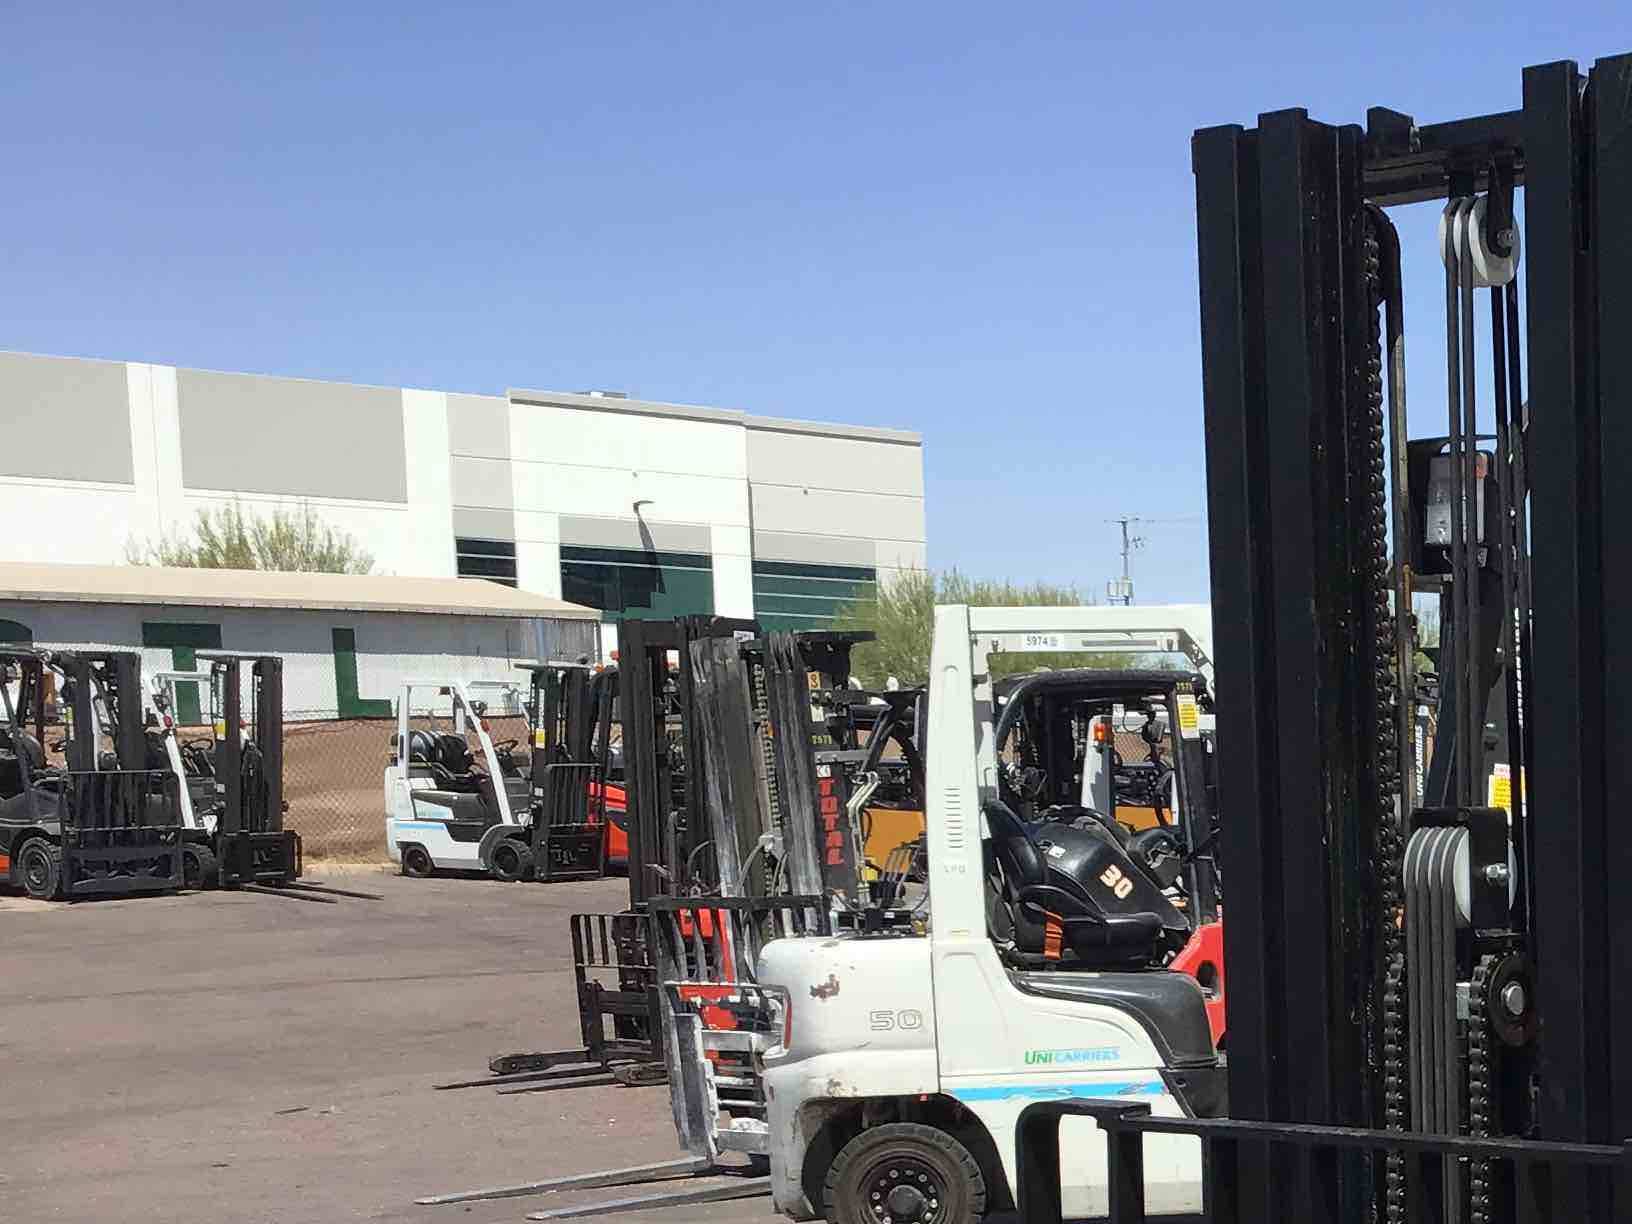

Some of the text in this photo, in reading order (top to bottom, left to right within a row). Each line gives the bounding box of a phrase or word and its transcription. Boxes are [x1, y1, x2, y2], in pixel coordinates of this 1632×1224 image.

[1026, 634, 1048, 647] 5974
[1100, 864, 1133, 899] 30
[869, 1010, 922, 1031] 50
